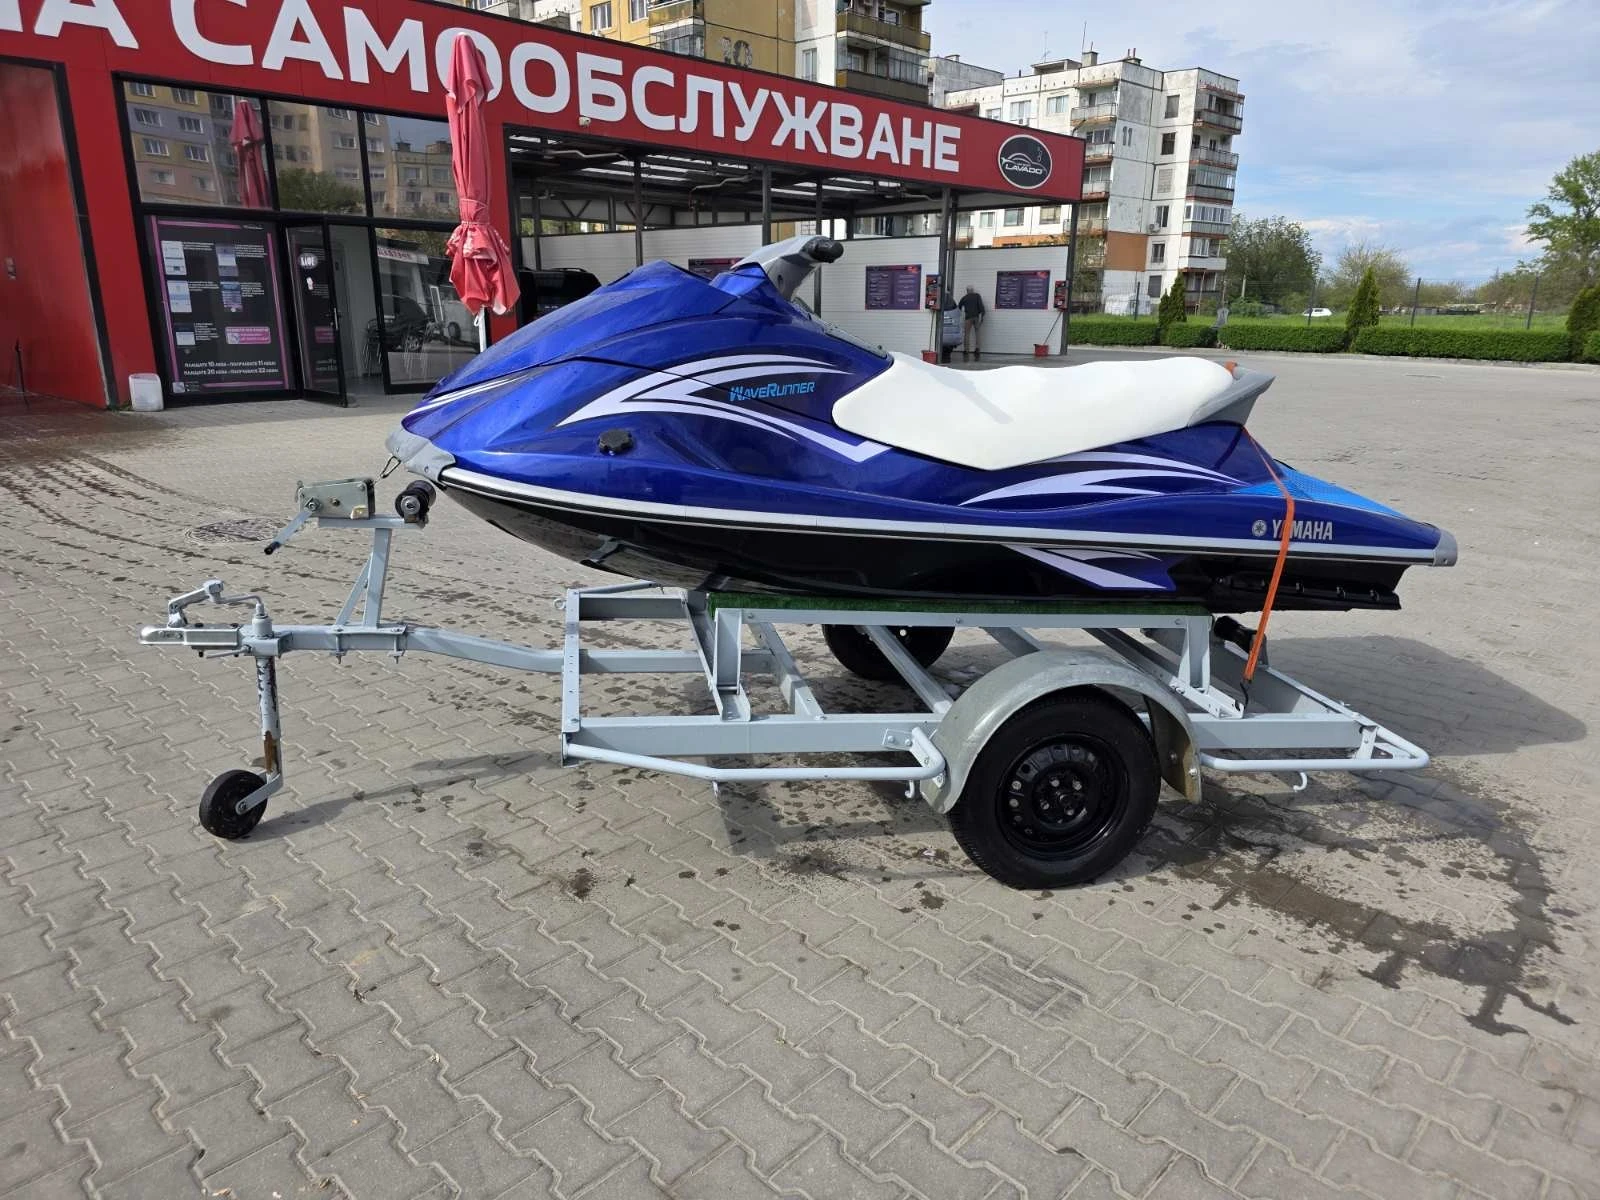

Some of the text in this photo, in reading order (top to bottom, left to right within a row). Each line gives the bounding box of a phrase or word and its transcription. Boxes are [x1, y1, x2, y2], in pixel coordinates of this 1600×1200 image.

[170, 0, 961, 172] САМООБСЛУЖВАНЕ
[1005, 163, 1043, 175] LAVADO
[1272, 519, 1333, 540] YMAHA
